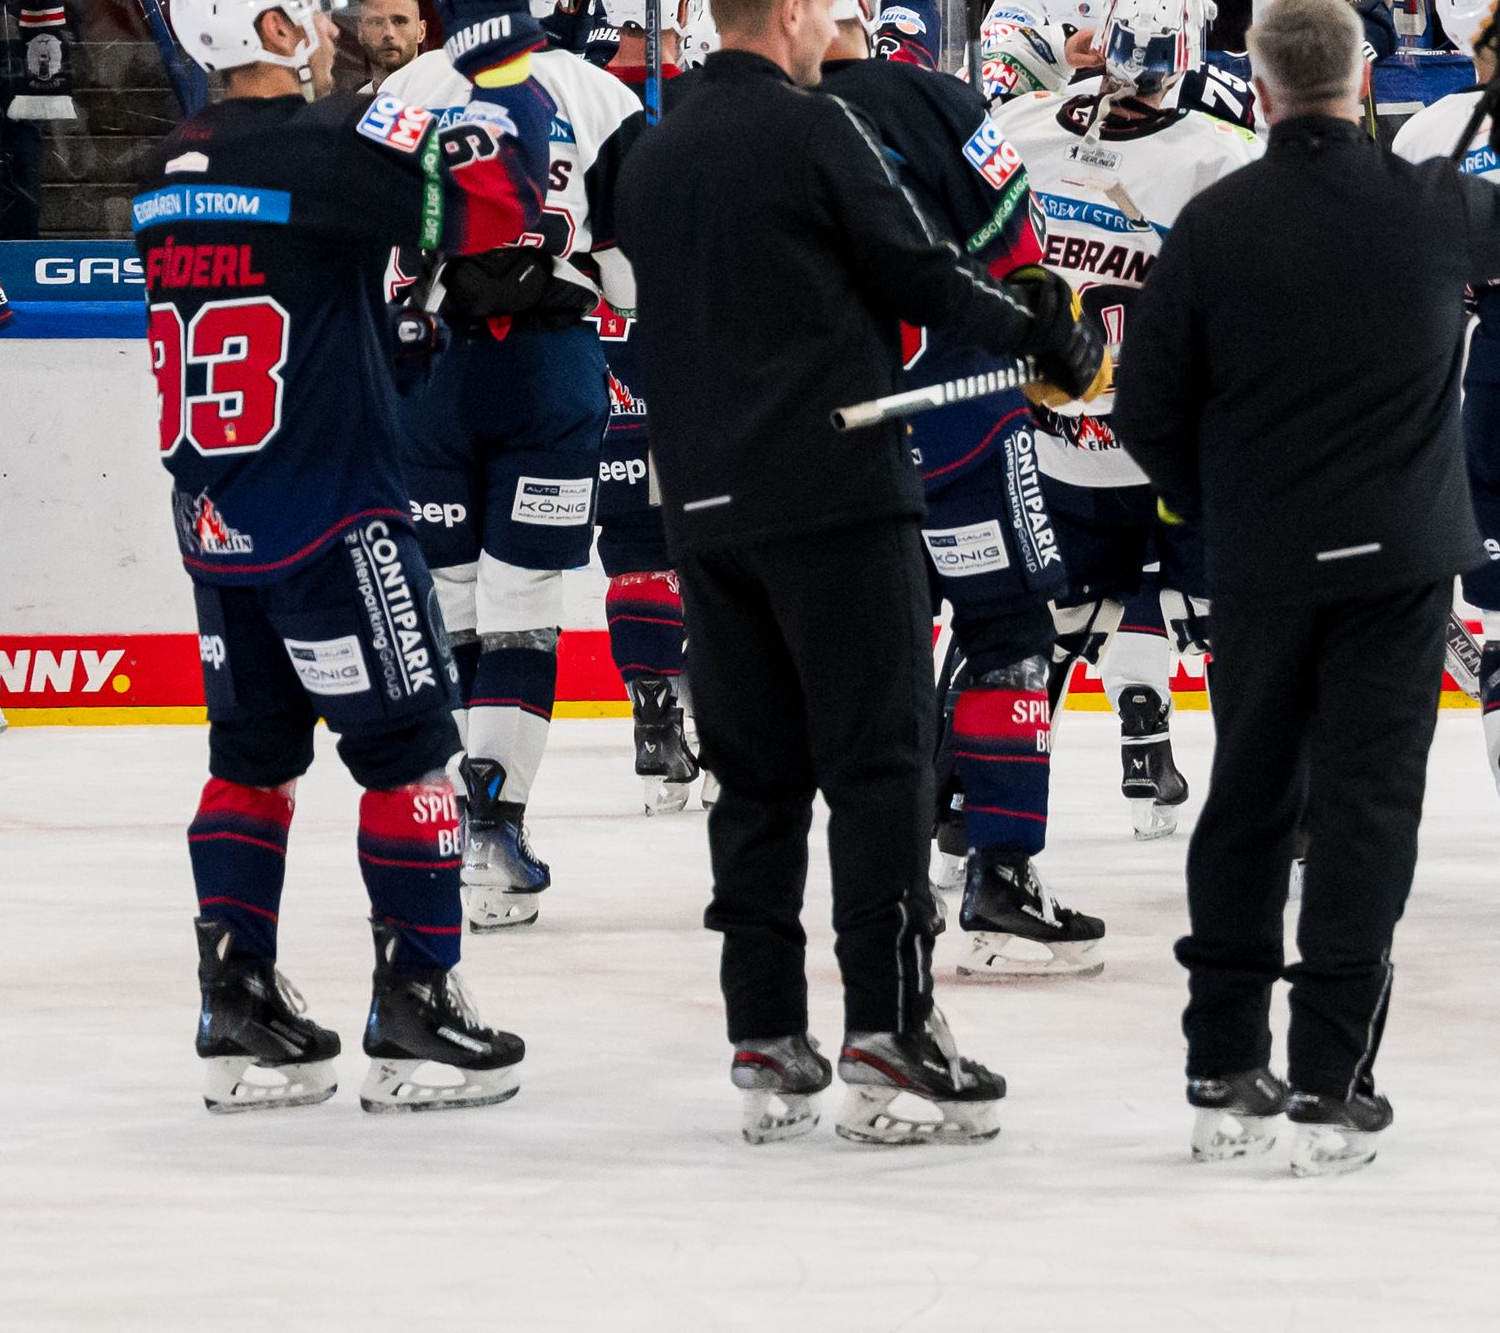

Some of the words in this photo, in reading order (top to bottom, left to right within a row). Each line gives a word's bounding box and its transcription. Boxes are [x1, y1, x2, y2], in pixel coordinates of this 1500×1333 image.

[194, 192, 261, 217] STROM
[36, 255, 146, 285] GAS
[146, 236, 267, 290] FDERL
[1042, 235, 1159, 283] EBRAN
[599, 455, 647, 487] eep
[518, 498, 589, 515] KÖNIG
[365, 522, 437, 695] CONTIPARK
